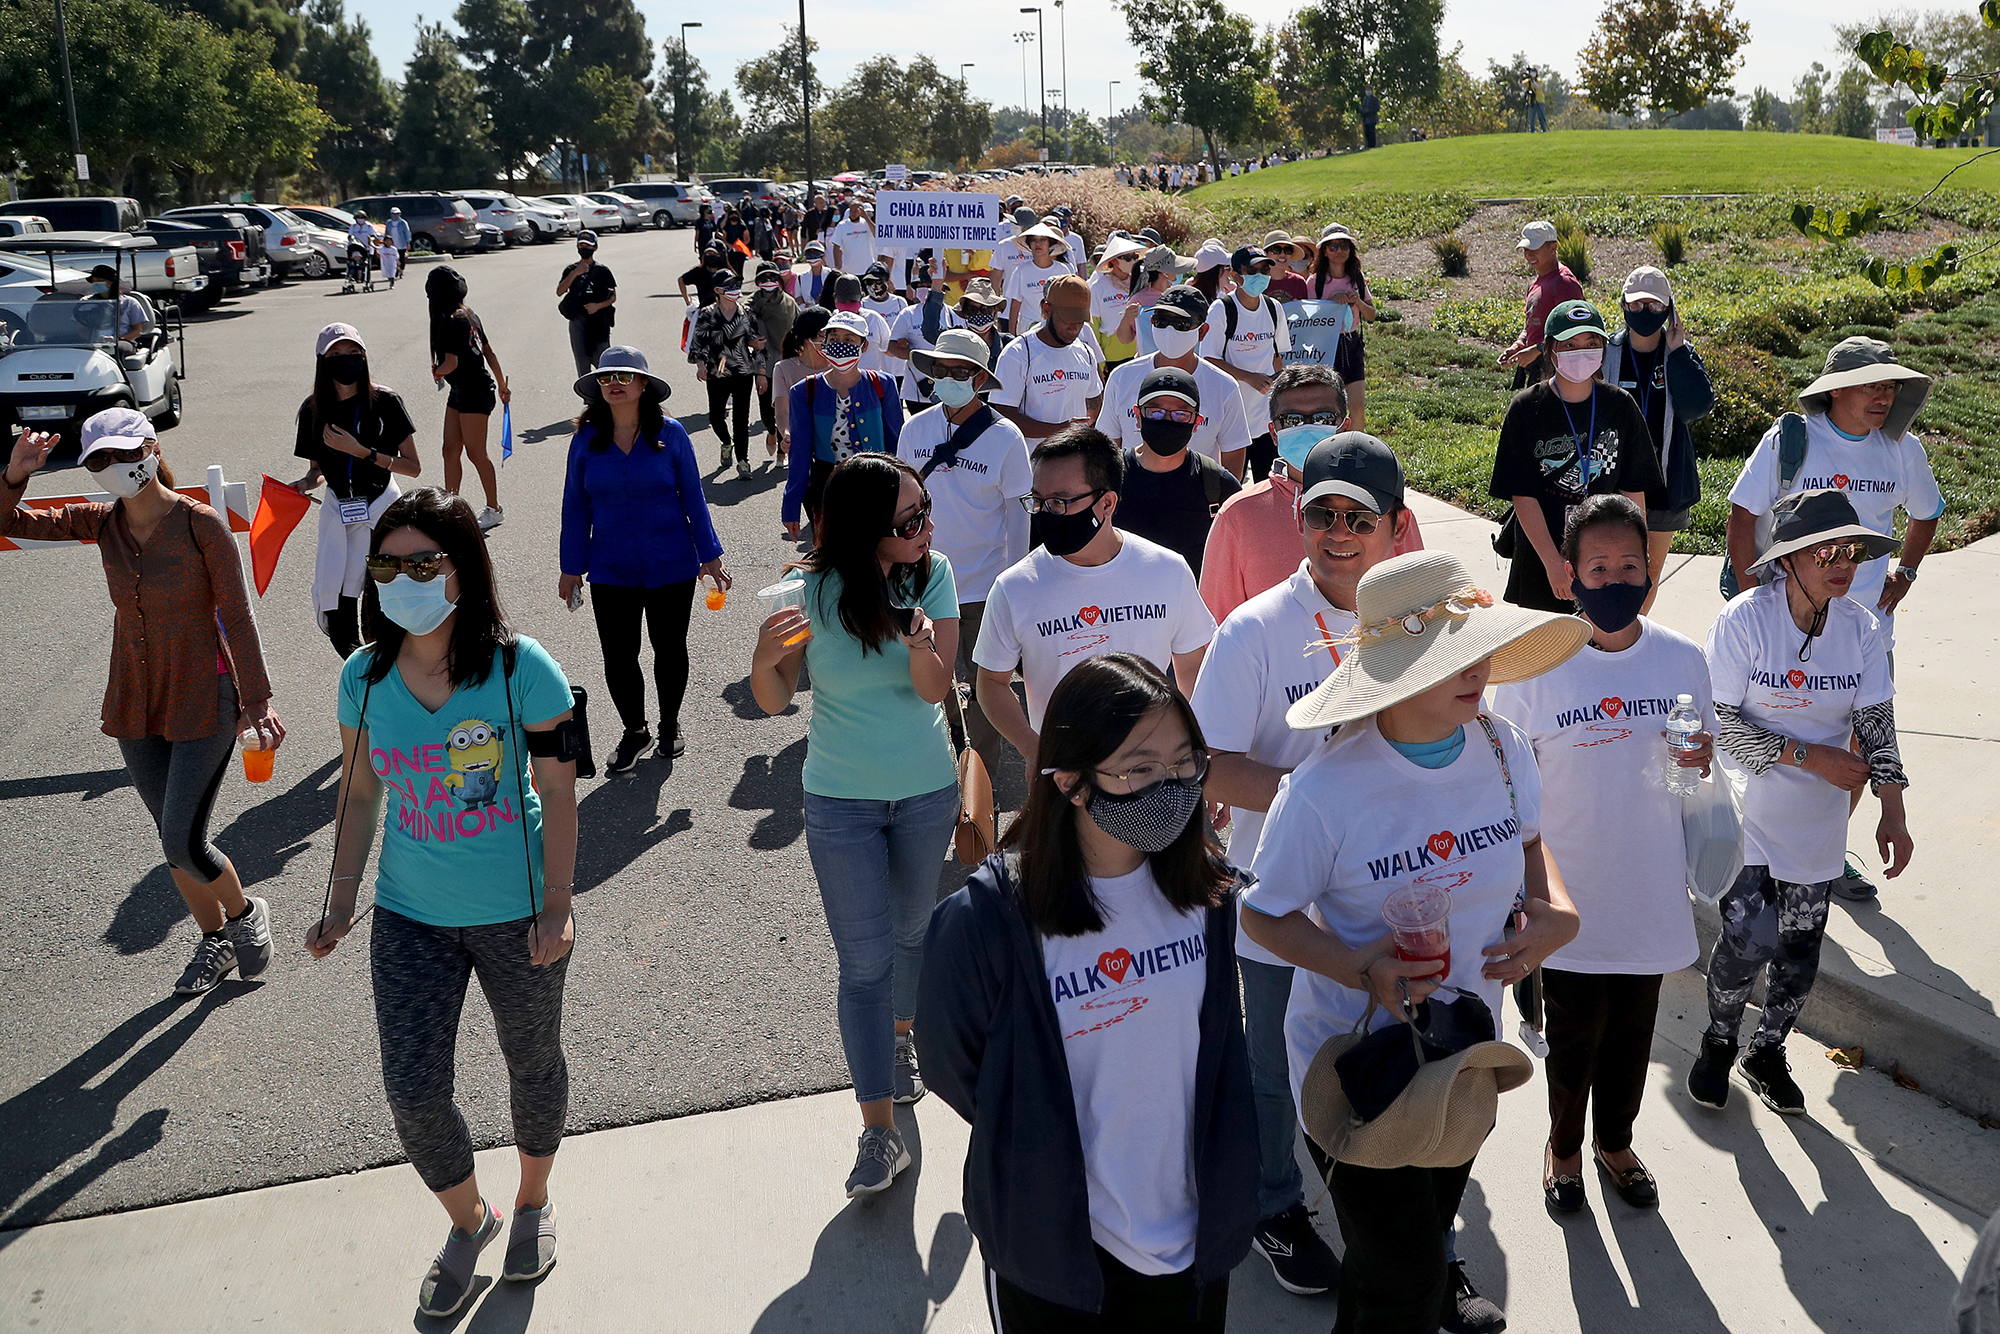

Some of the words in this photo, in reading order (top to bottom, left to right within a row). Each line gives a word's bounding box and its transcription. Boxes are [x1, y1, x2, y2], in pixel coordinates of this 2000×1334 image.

[890, 200, 925, 217] CHÙA
[929, 200, 954, 218] BÁT
[958, 201, 985, 218] NHÃ
[878, 225, 894, 238] BAT
[896, 225, 914, 239] NHA
[917, 225, 960, 240] BUDDHIST
[962, 226, 996, 241] TEMPLE
[1254, 332, 1273, 341] VIETNA
[1033, 372, 1056, 384] WALK
[914, 448, 936, 459] WAL
[956, 456, 988, 475] ETNAM
[1848, 478, 1896, 493] VIETNAM
[1036, 613, 1084, 637] WALK
[1083, 609, 1097, 620] for
[1099, 603, 1167, 624] VIETNAM
[1790, 672, 1803, 682] for
[1285, 680, 1325, 704] WA
[1556, 704, 1605, 728] WALK
[1605, 700, 1619, 711] for
[1622, 698, 1678, 717] VIETNA
[370, 743, 446, 777] ONE
[423, 776, 455, 810] A
[1366, 843, 1436, 881] WALK
[1433, 837, 1450, 852] for
[1048, 963, 1107, 1003] ALK
[1105, 956, 1125, 973] for
